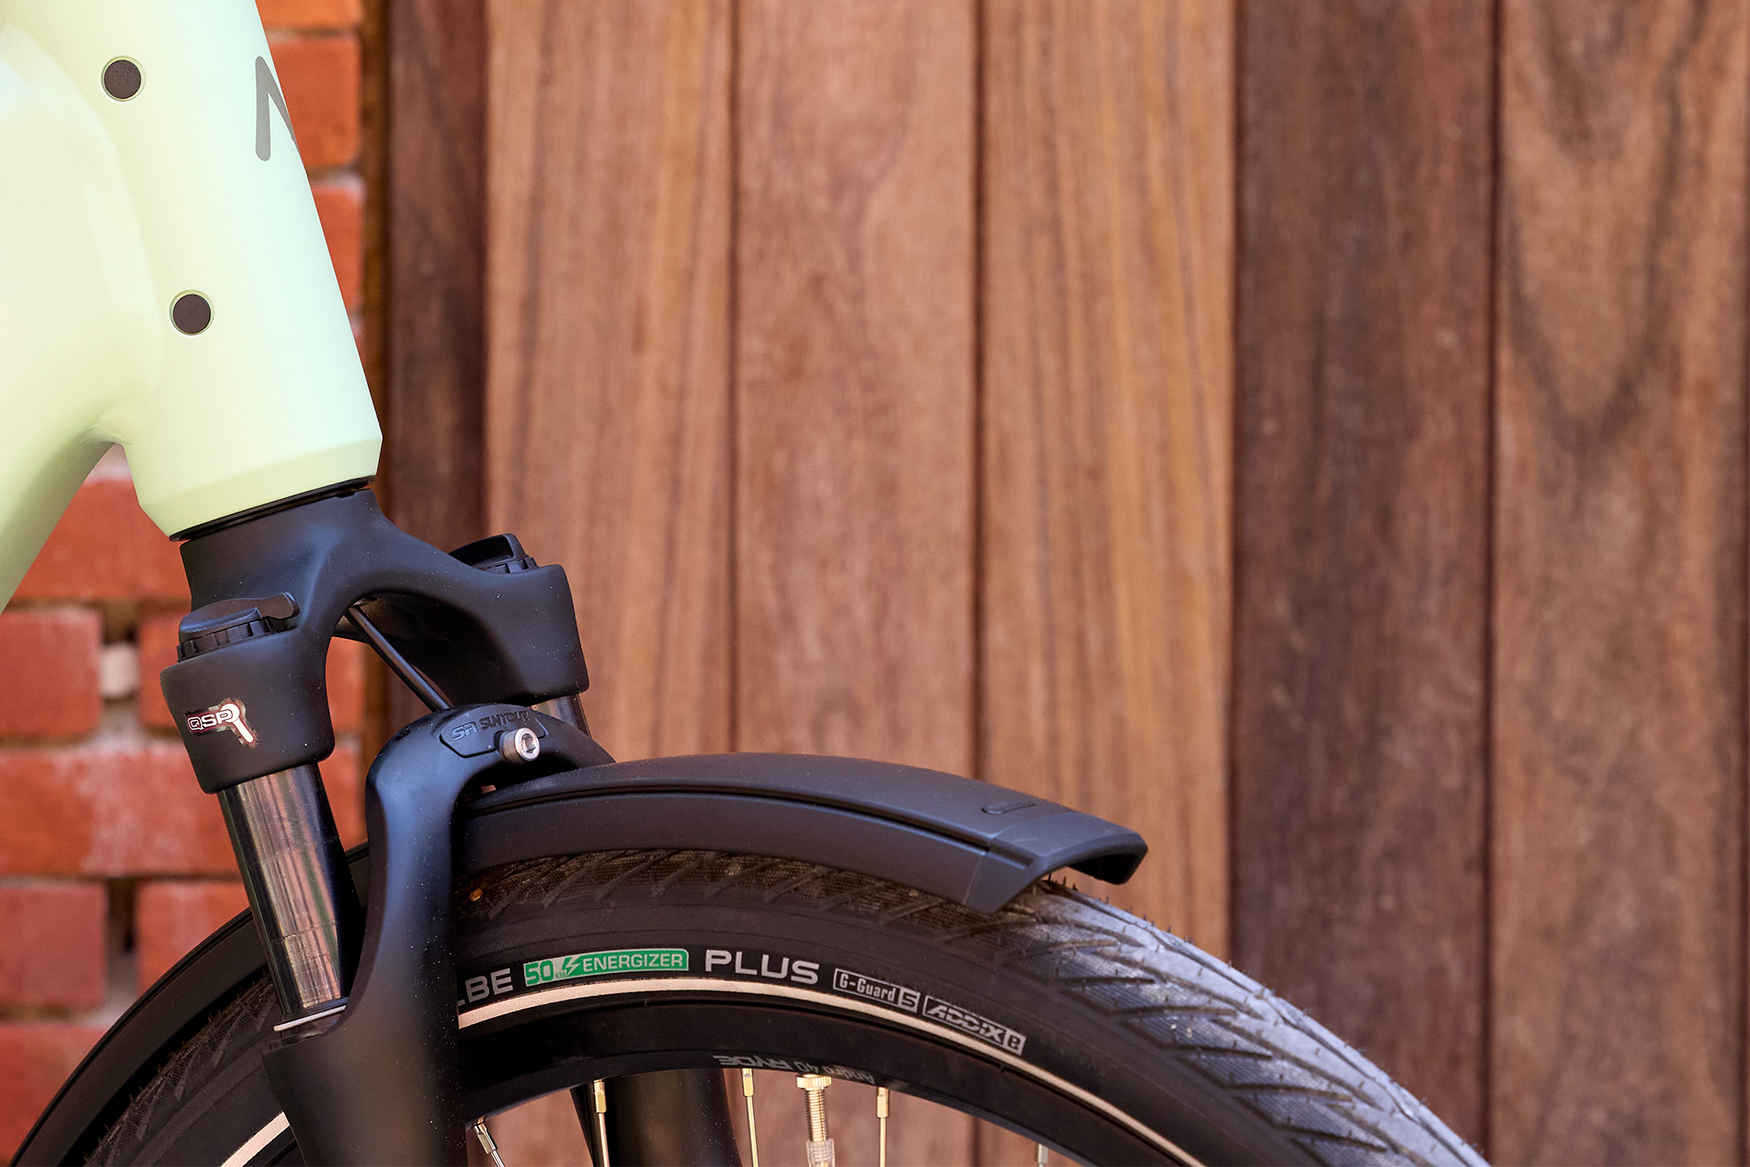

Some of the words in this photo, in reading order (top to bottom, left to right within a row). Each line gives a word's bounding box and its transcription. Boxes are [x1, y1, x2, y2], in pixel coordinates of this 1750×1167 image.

[451, 721, 478, 741] SR
[458, 967, 514, 1007] BE
[525, 959, 554, 985] 50
[582, 953, 684, 972] ENERGIZER
[704, 949, 820, 985] PLUS
[839, 973, 897, 1002] G-Guard
[712, 1054, 794, 1071] RYDE
[794, 1061, 820, 1074] 40
[821, 1064, 876, 1085] Andro
